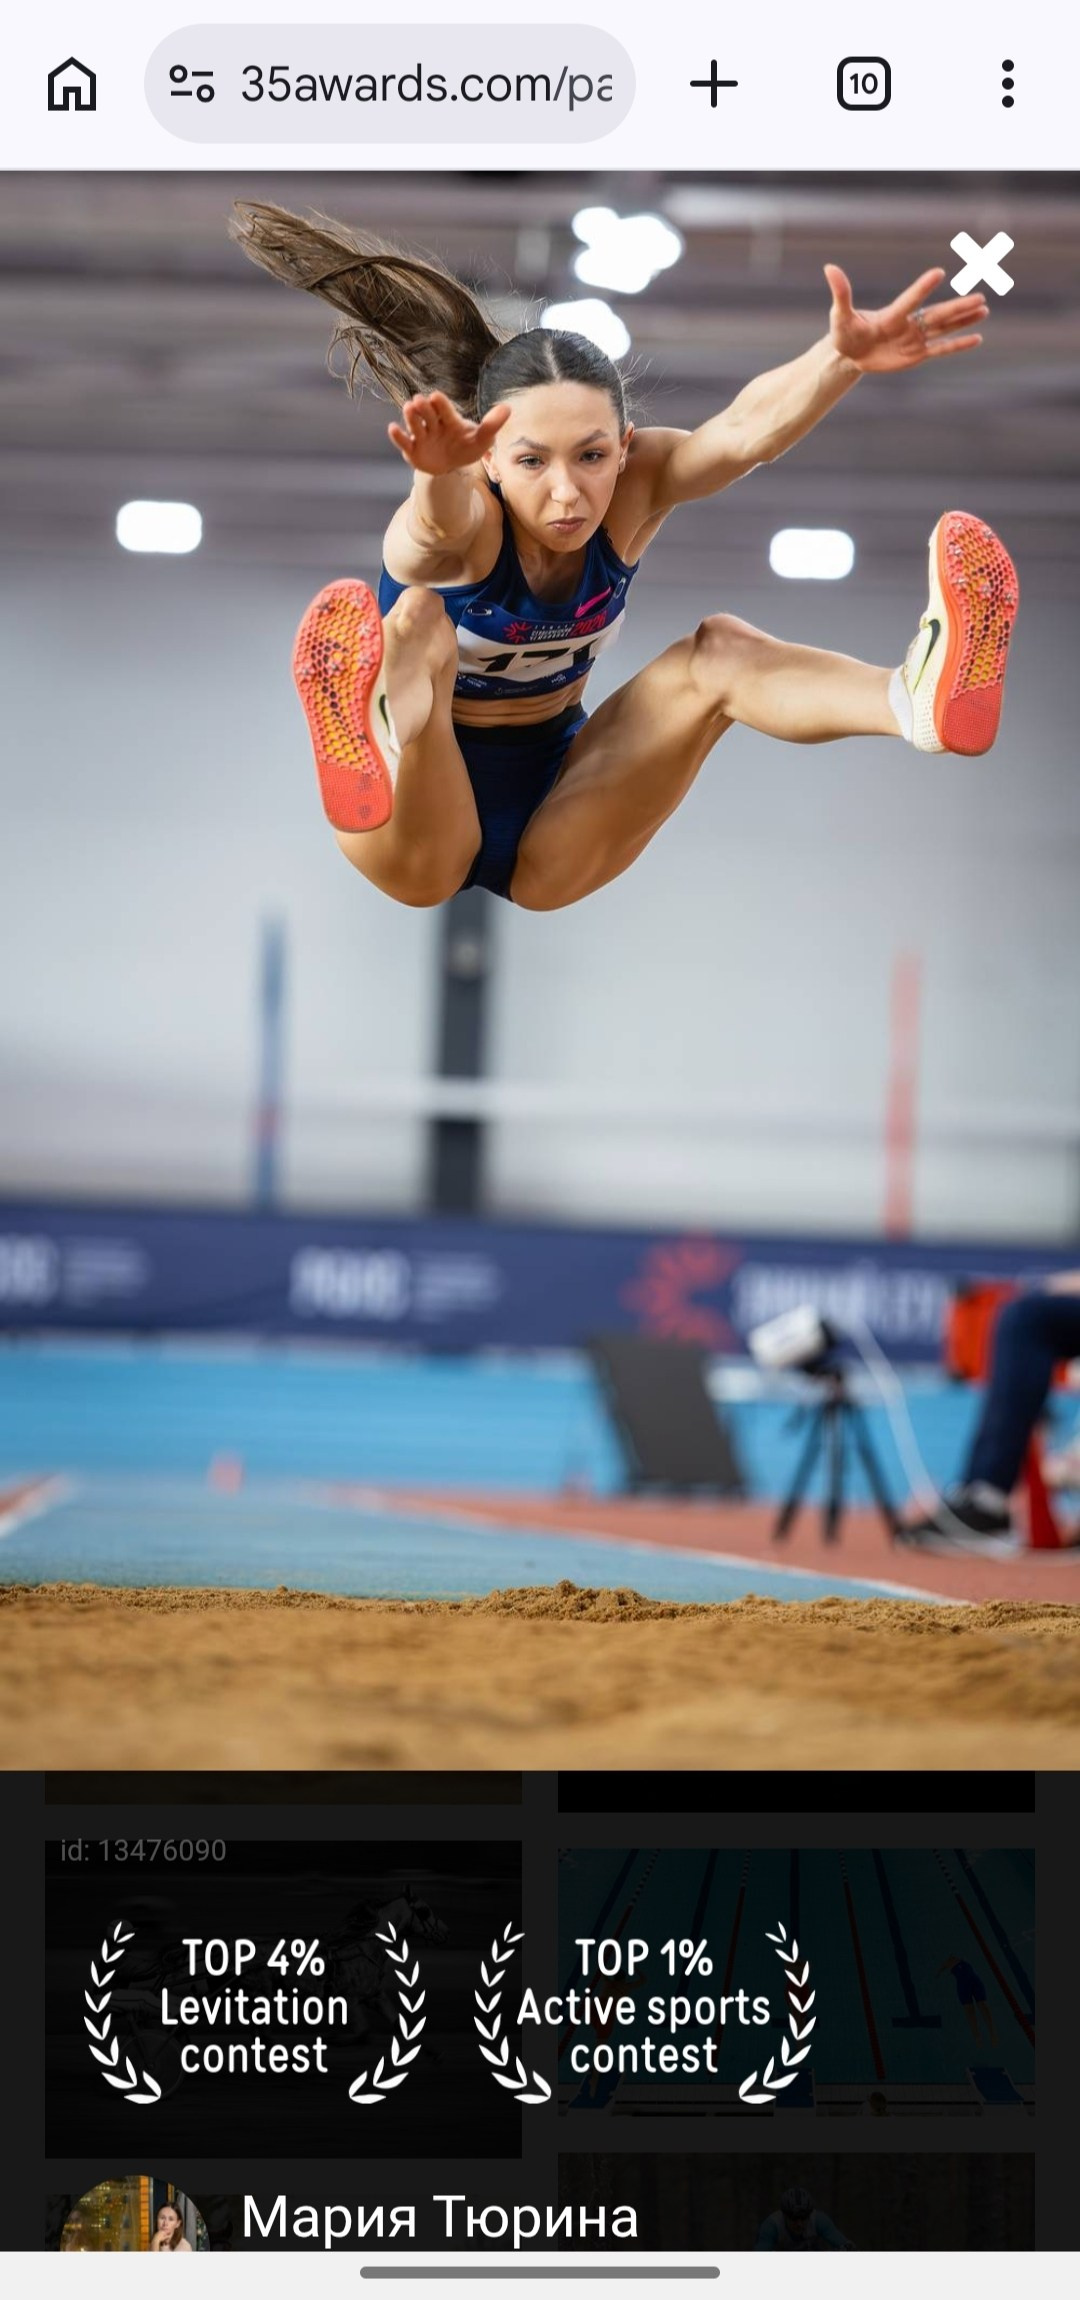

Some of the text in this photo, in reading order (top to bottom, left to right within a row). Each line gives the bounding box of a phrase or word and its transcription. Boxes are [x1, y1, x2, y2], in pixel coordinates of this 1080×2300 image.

[849, 72, 879, 95] 10
[61, 1838, 227, 1861] id: 13476090
[182, 1938, 326, 1976] TOP 4%
[575, 1938, 714, 1976] TOP 1%
[161, 1986, 349, 2025] Levitation
[516, 1986, 771, 2035] Active sports
[180, 2036, 329, 2073] contest
[570, 2036, 719, 2073] contest
[243, 2195, 639, 2250] Мария Тюрина
